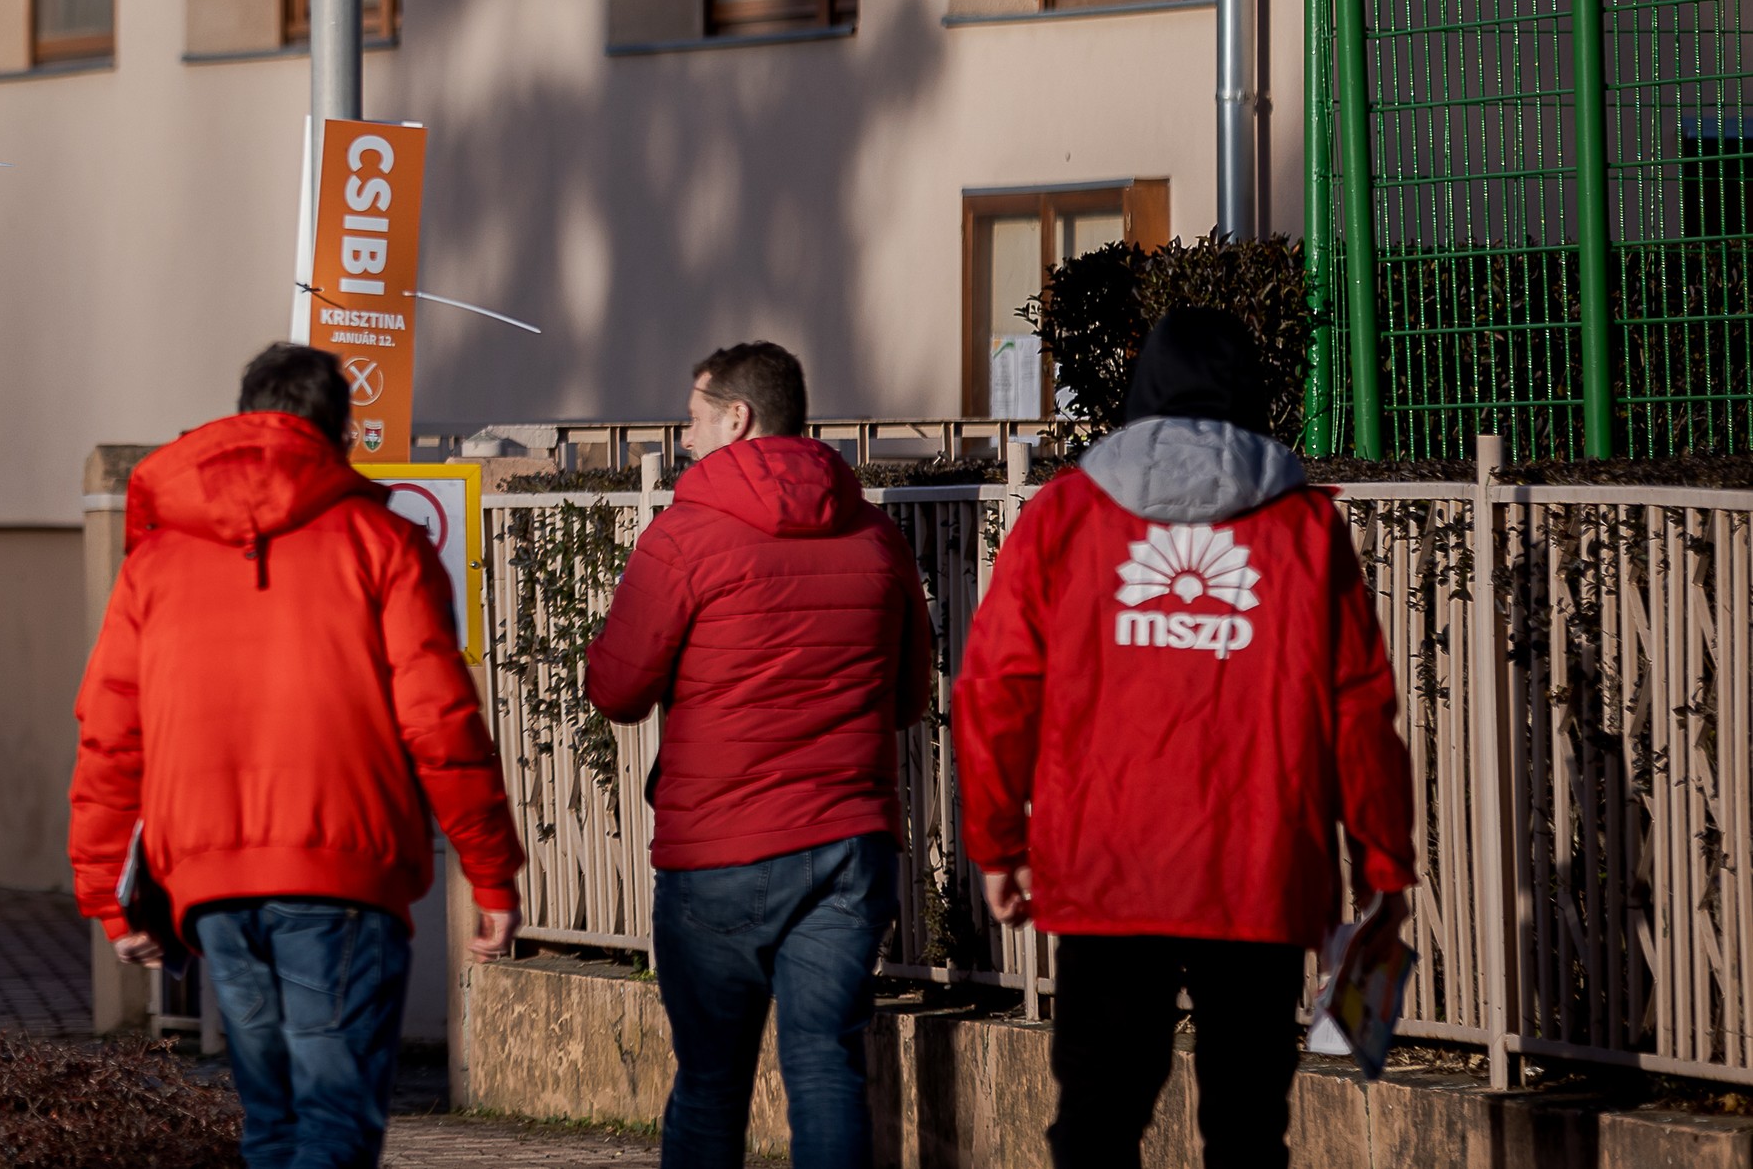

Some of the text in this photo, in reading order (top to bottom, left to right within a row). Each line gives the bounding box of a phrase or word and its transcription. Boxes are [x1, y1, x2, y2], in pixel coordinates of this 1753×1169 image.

[339, 135, 395, 296] CSIBI
[320, 308, 406, 331] KRISZTINA
[330, 331, 396, 347] JANUÁR 12.
[1114, 609, 1254, 660] mszp
